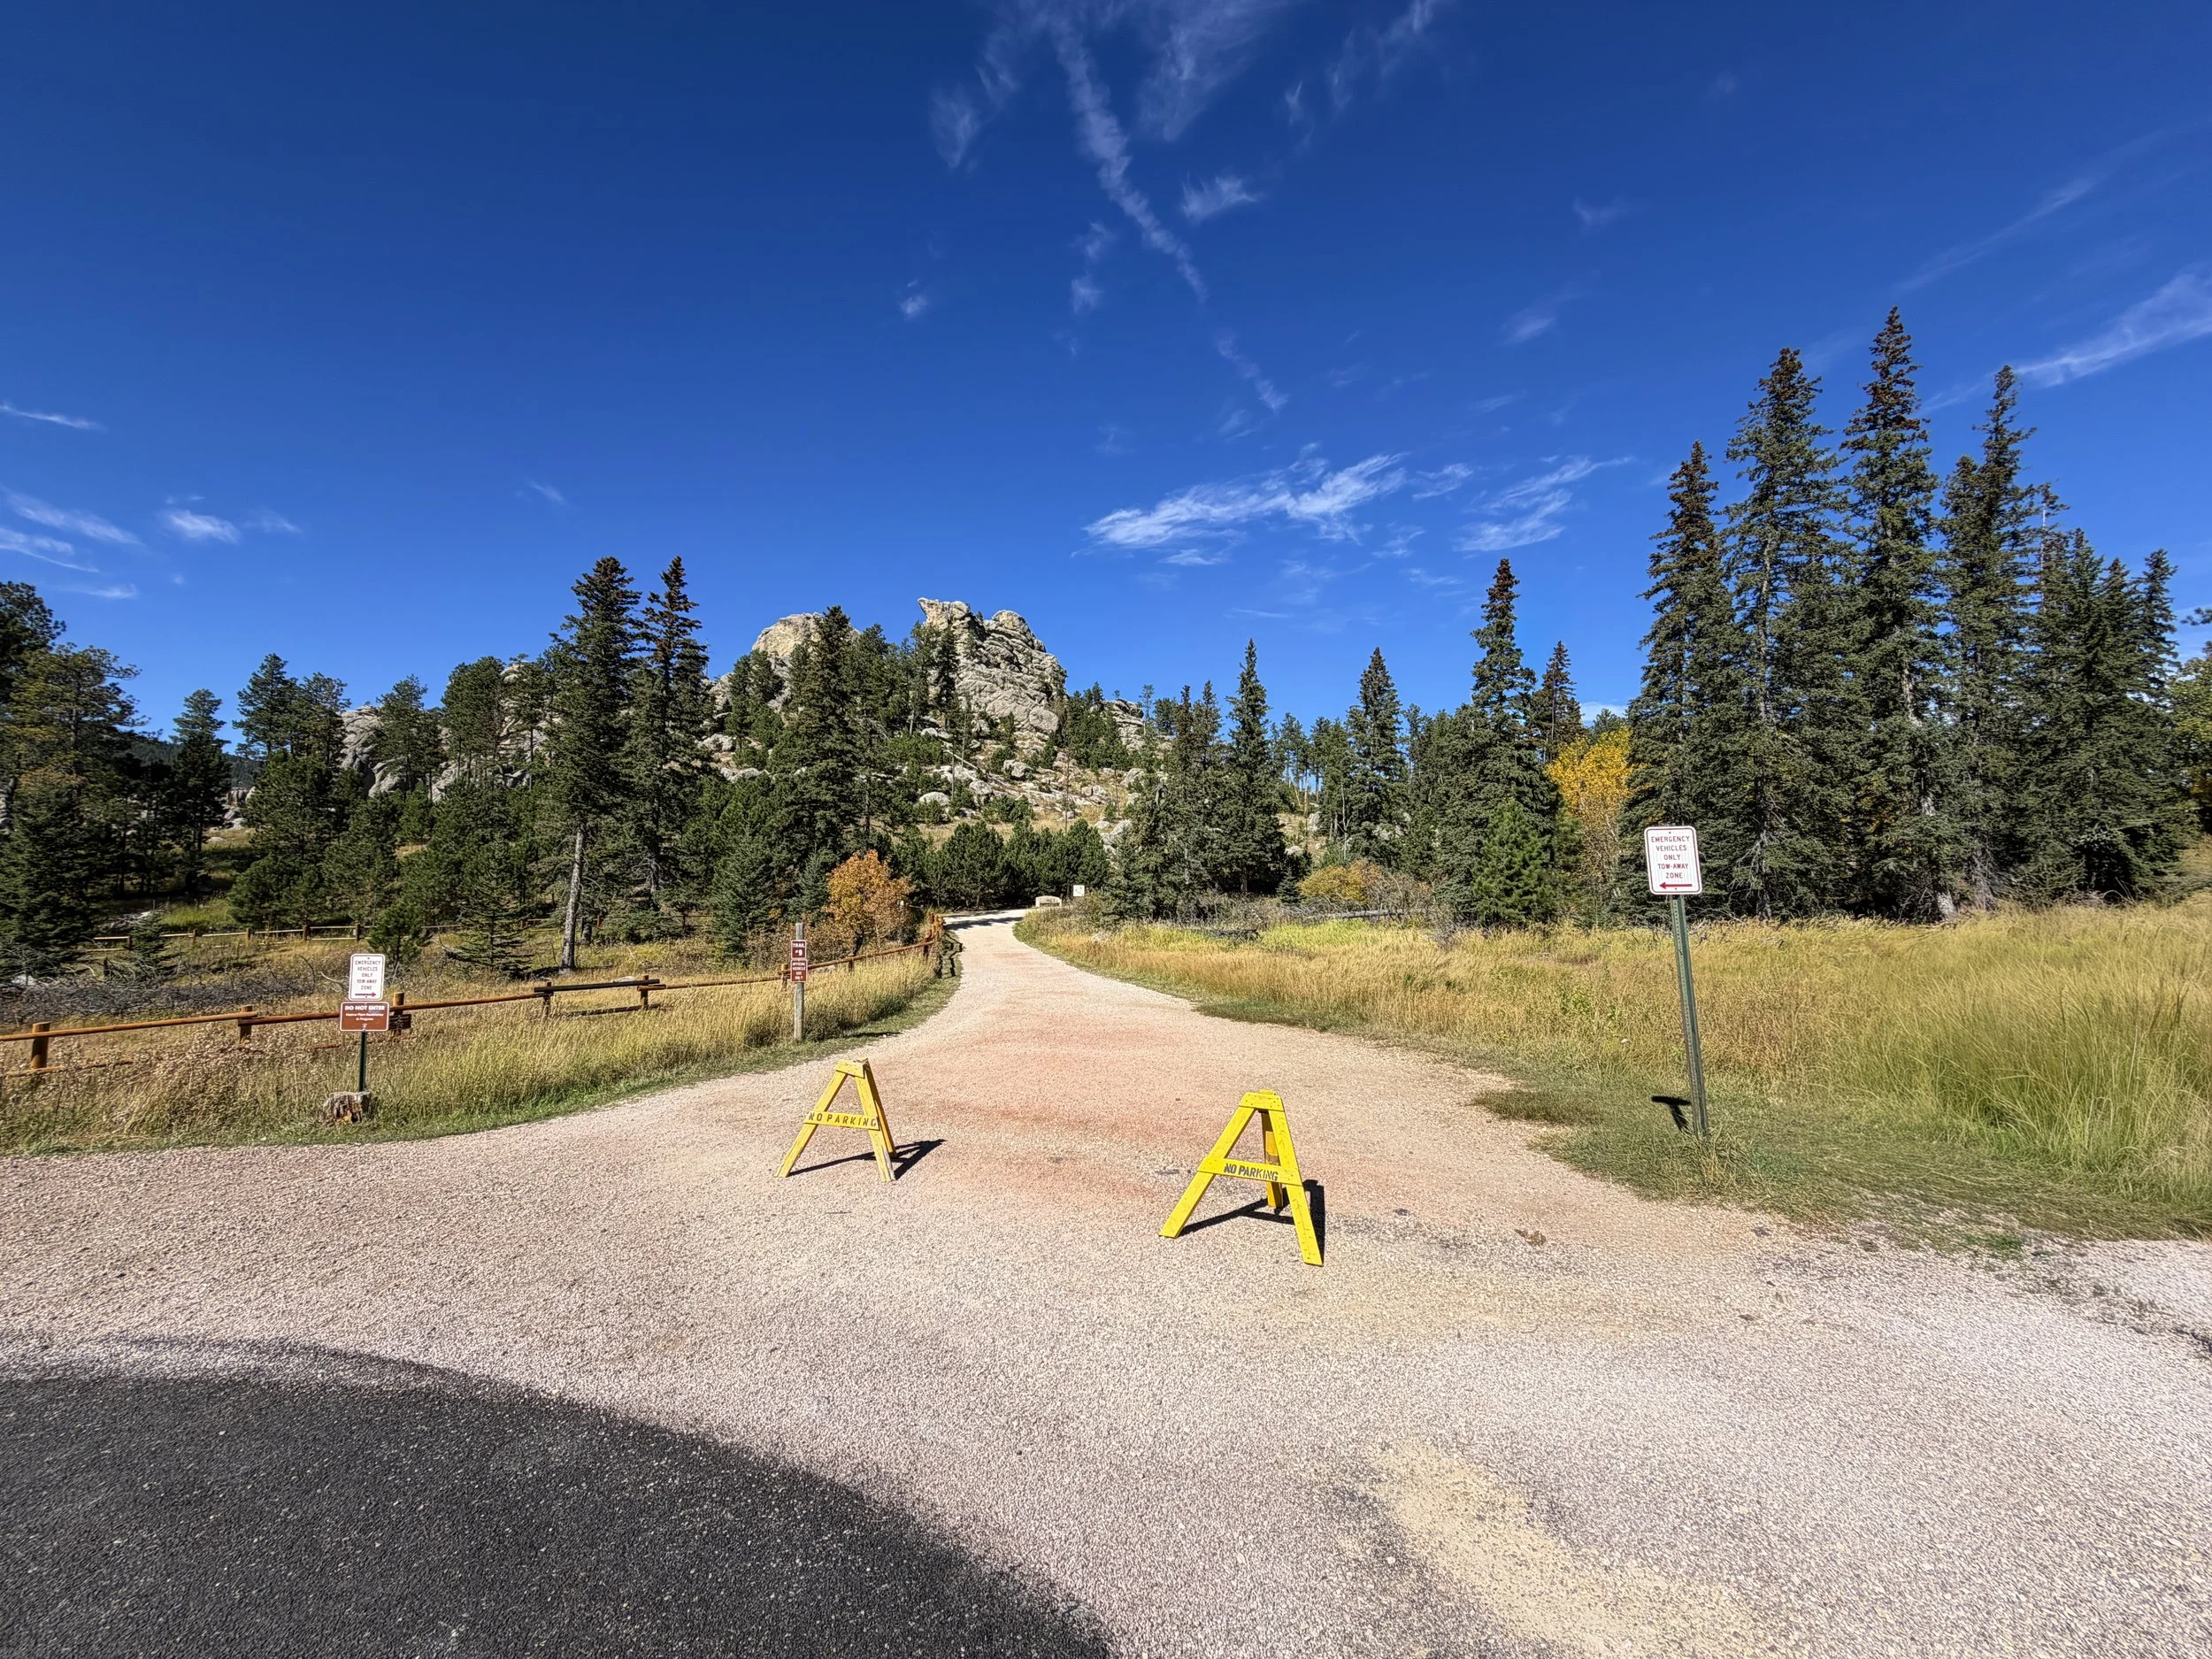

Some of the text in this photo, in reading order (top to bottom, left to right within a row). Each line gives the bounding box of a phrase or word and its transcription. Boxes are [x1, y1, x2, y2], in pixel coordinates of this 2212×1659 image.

[809, 1112, 876, 1127] NO PARKING
[1224, 1163, 1278, 1181] NO PARKING
